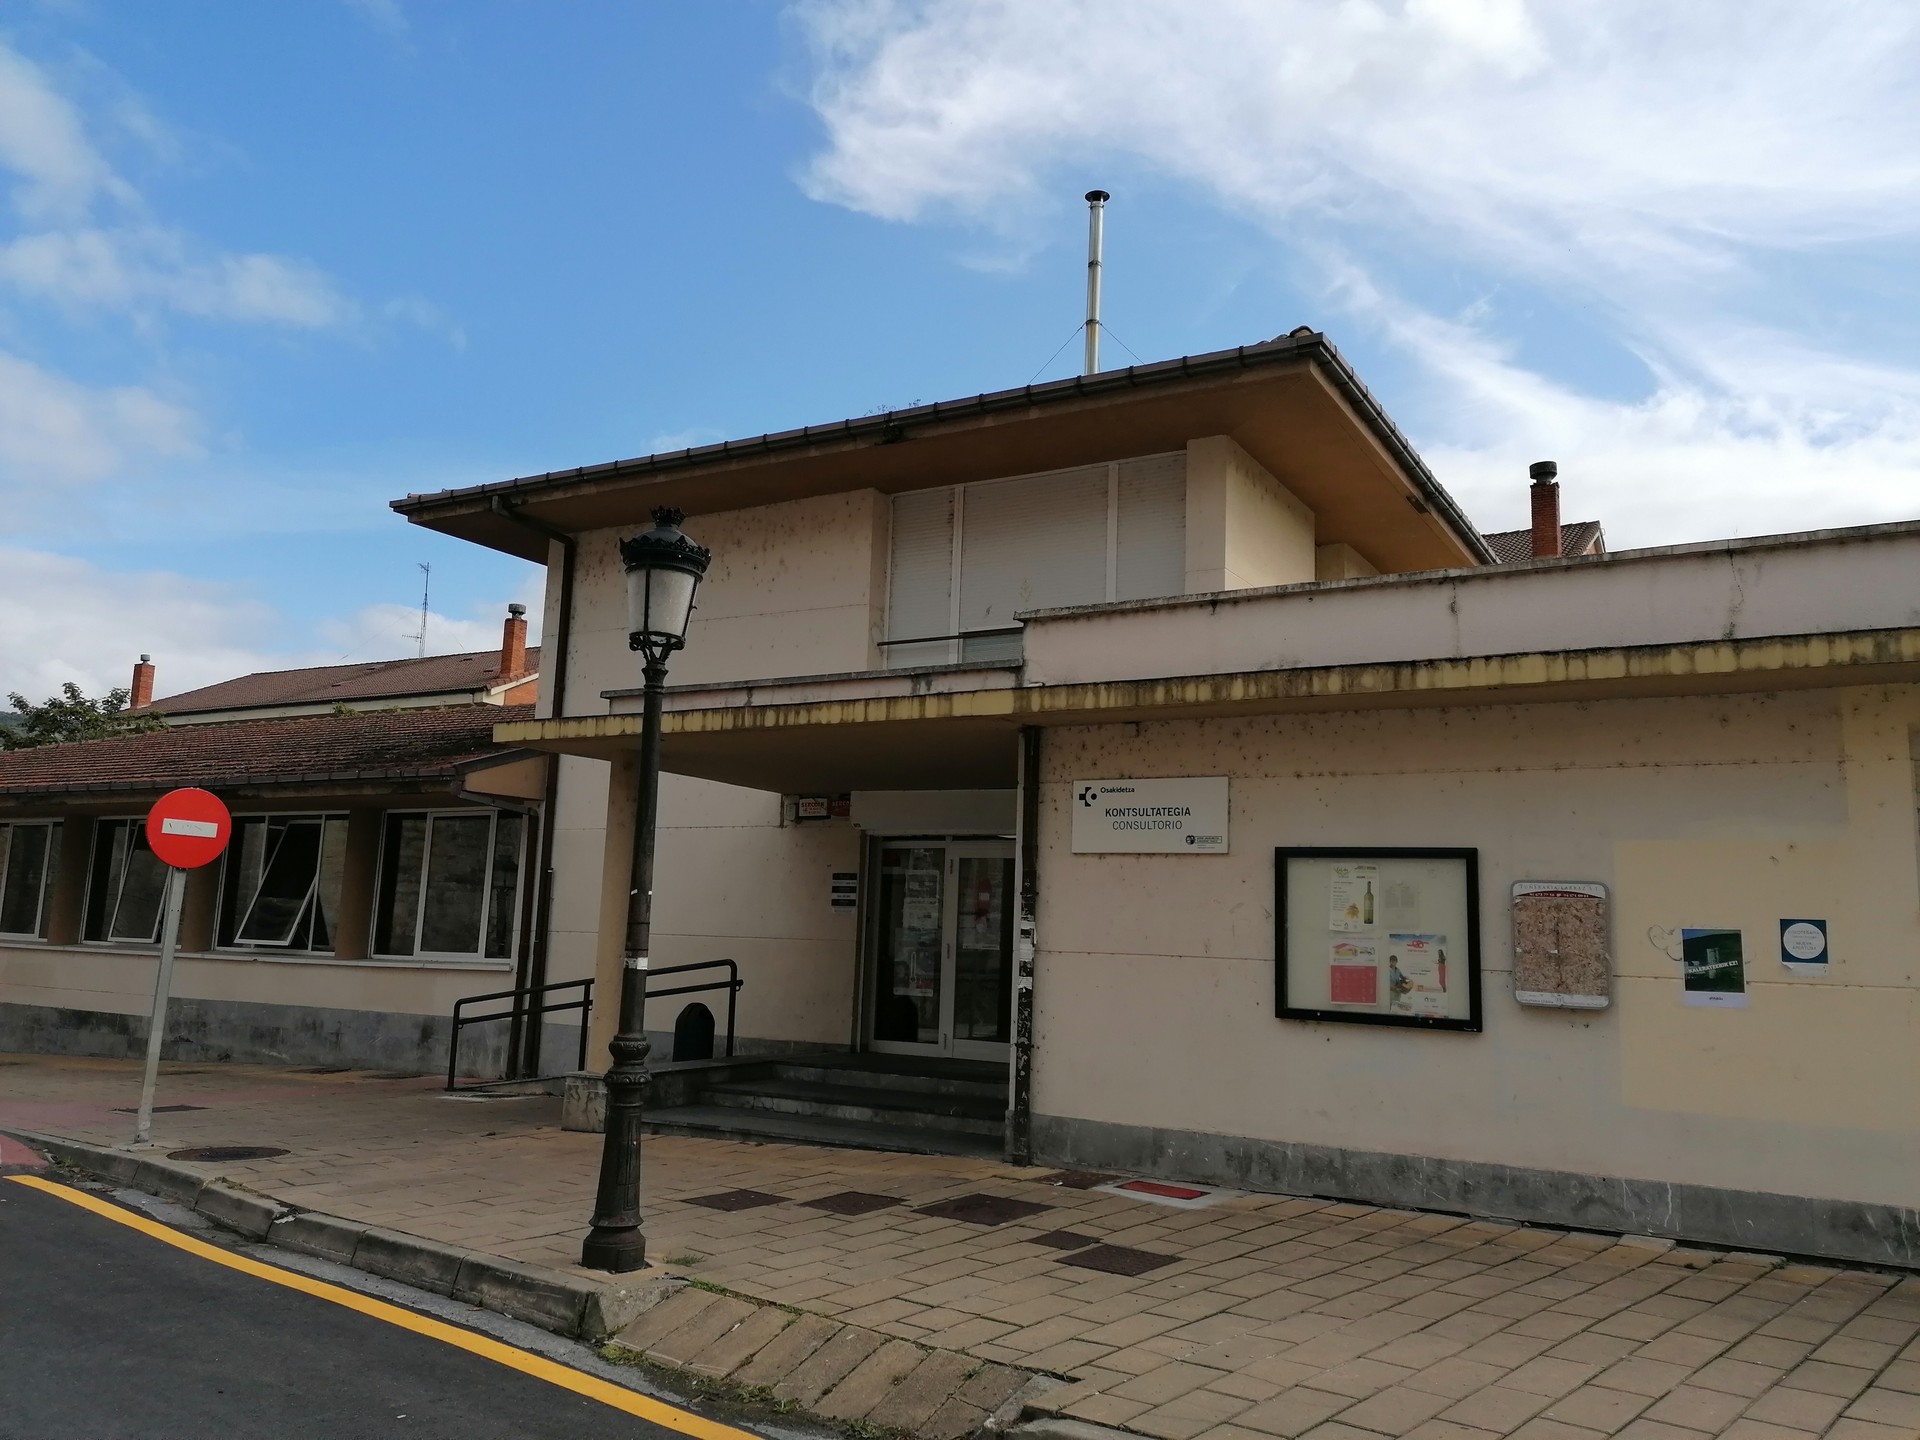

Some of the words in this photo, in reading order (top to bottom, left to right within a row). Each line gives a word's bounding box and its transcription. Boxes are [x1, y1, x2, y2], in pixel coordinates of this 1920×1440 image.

[1100, 786, 1135, 794] Osakidetza
[1105, 807, 1192, 818] KONTSULTATEGIA
[1112, 820, 1183, 831] CONSULTORIO
